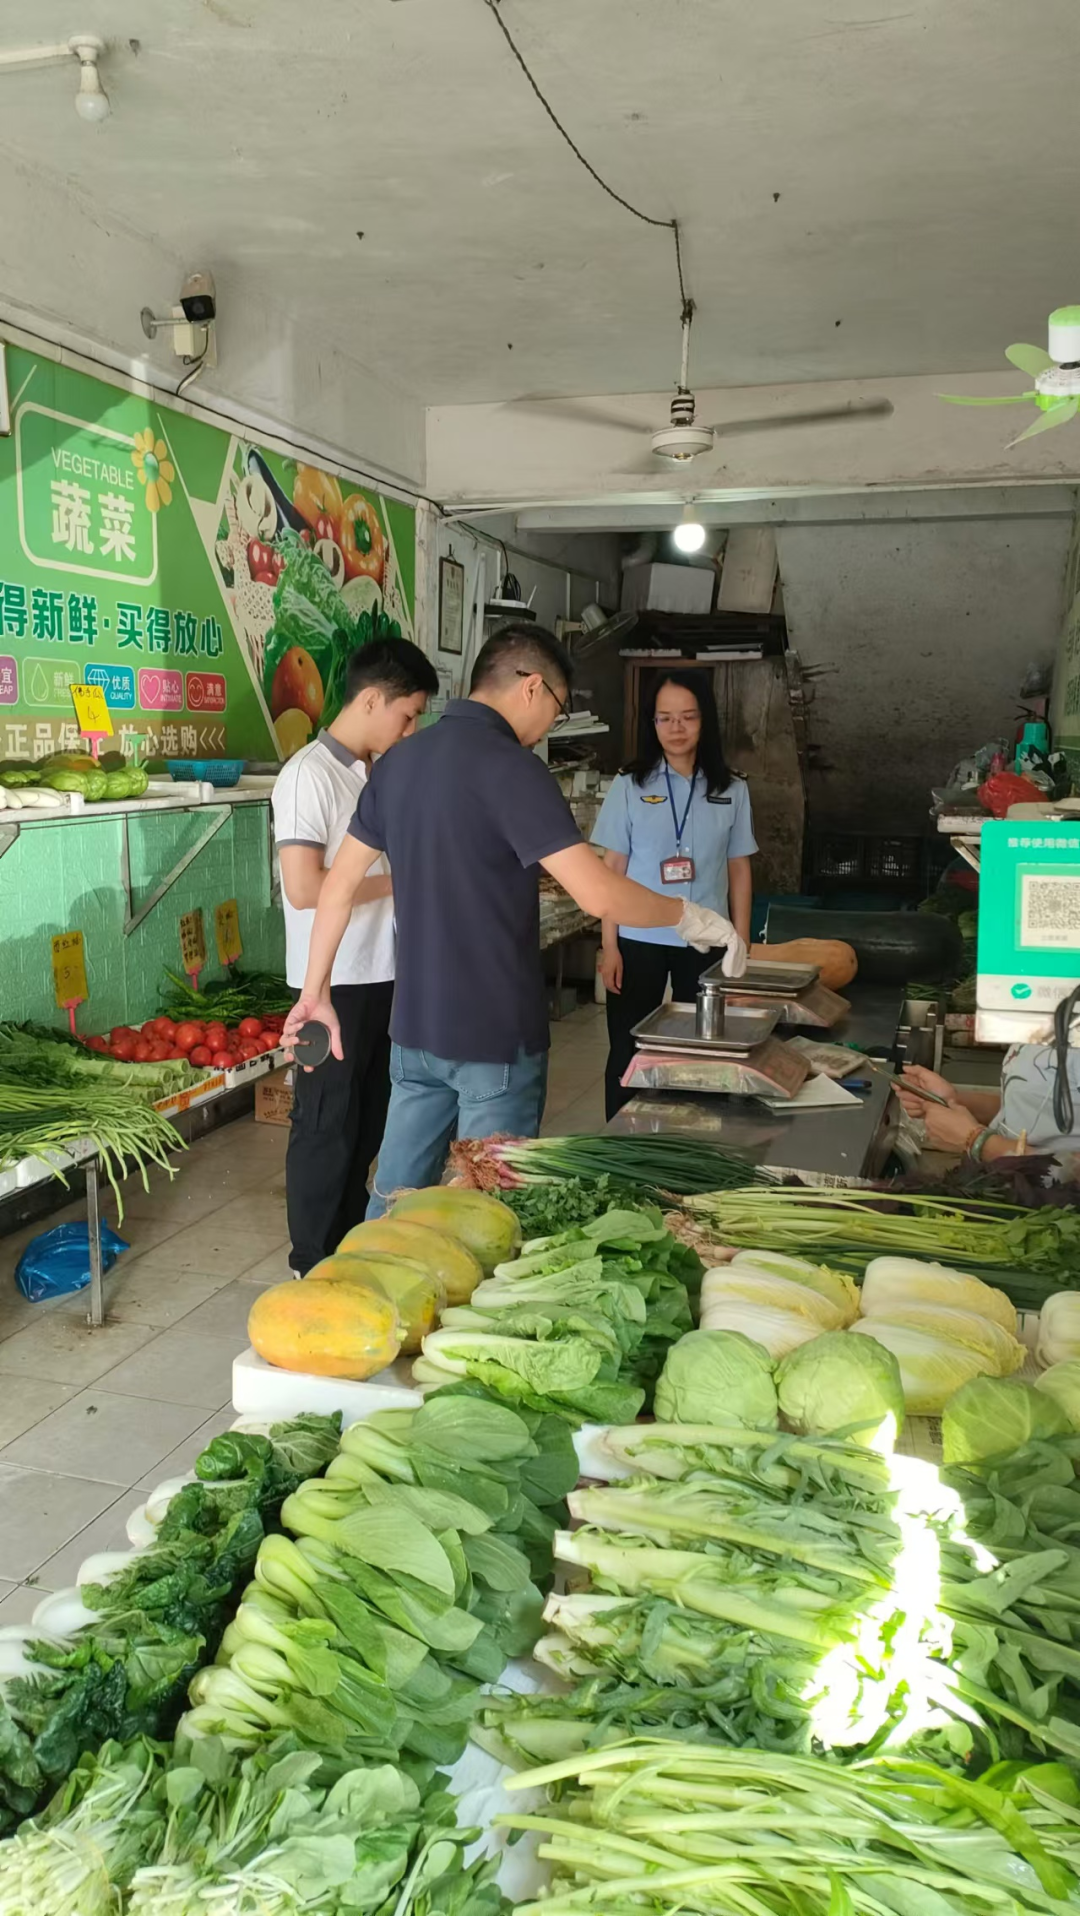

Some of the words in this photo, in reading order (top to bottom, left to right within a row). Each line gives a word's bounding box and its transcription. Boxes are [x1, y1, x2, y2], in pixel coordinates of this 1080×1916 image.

[51, 446, 134, 490] VEGETABLE
[50, 479, 137, 562] 蔬菜
[112, 675, 131, 691] 优质
[162, 679, 179, 694] 贴心
[110, 691, 133, 700] QUALITY
[87, 705, 101, 724] 4
